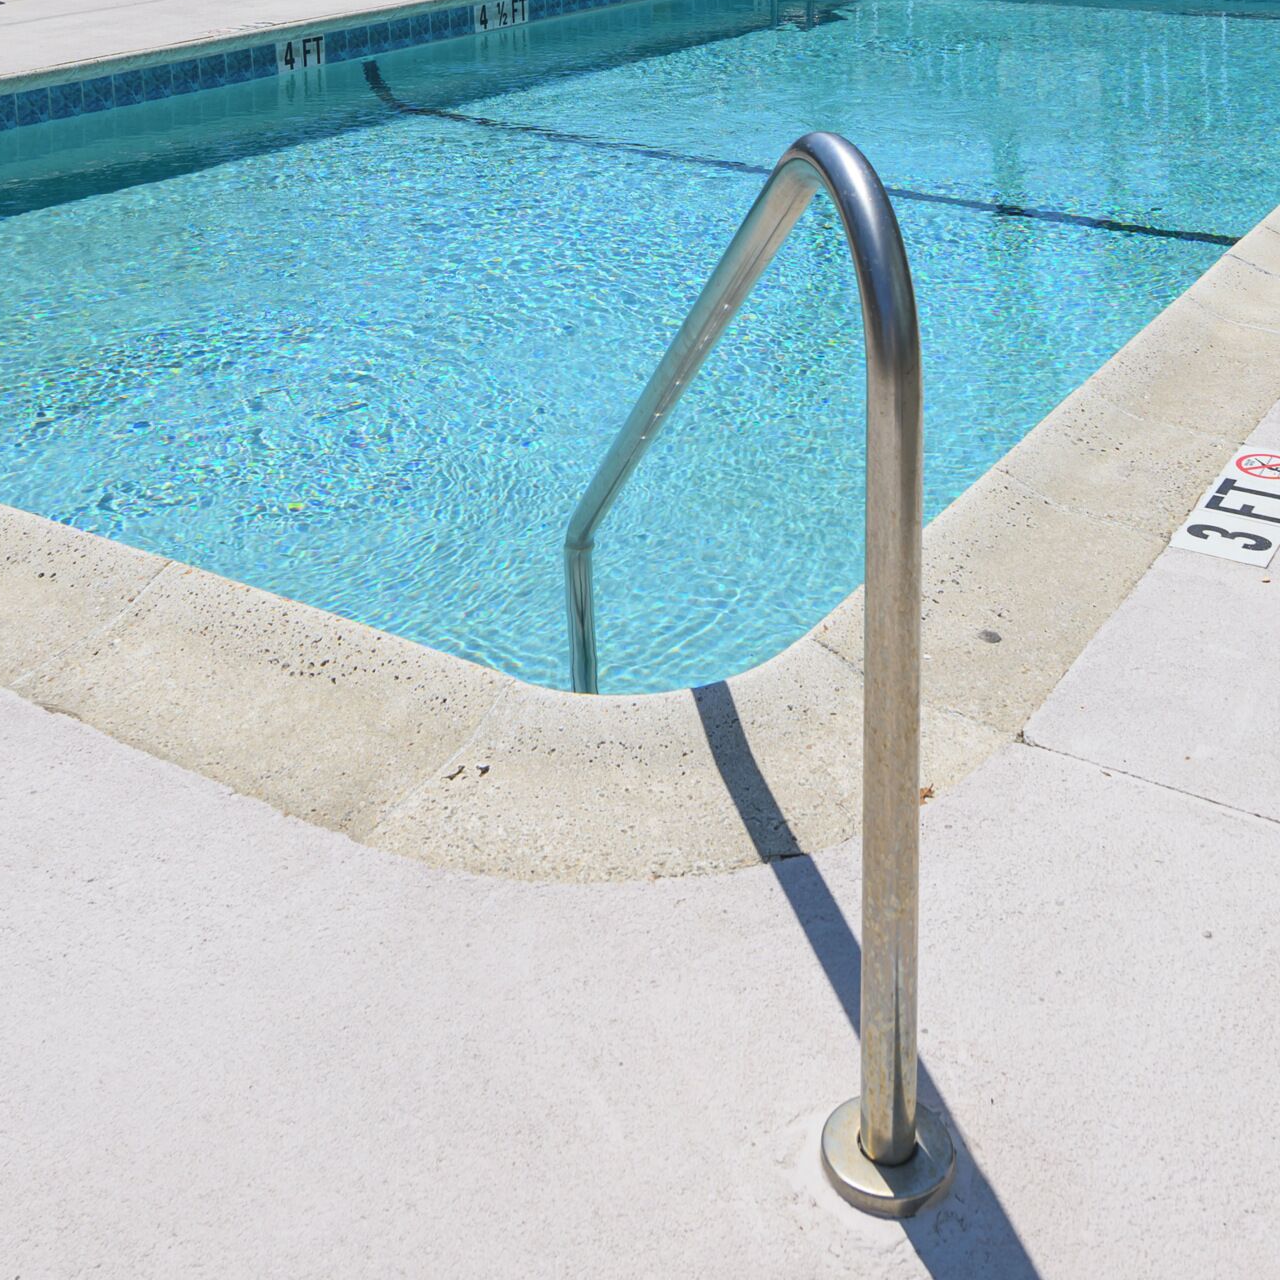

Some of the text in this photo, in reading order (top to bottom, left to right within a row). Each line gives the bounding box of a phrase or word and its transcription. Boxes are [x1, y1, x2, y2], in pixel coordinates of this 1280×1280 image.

[480, 4, 489, 30] 4
[284, 35, 324, 70] 4 FT
[1186, 523, 1273, 552] 3
